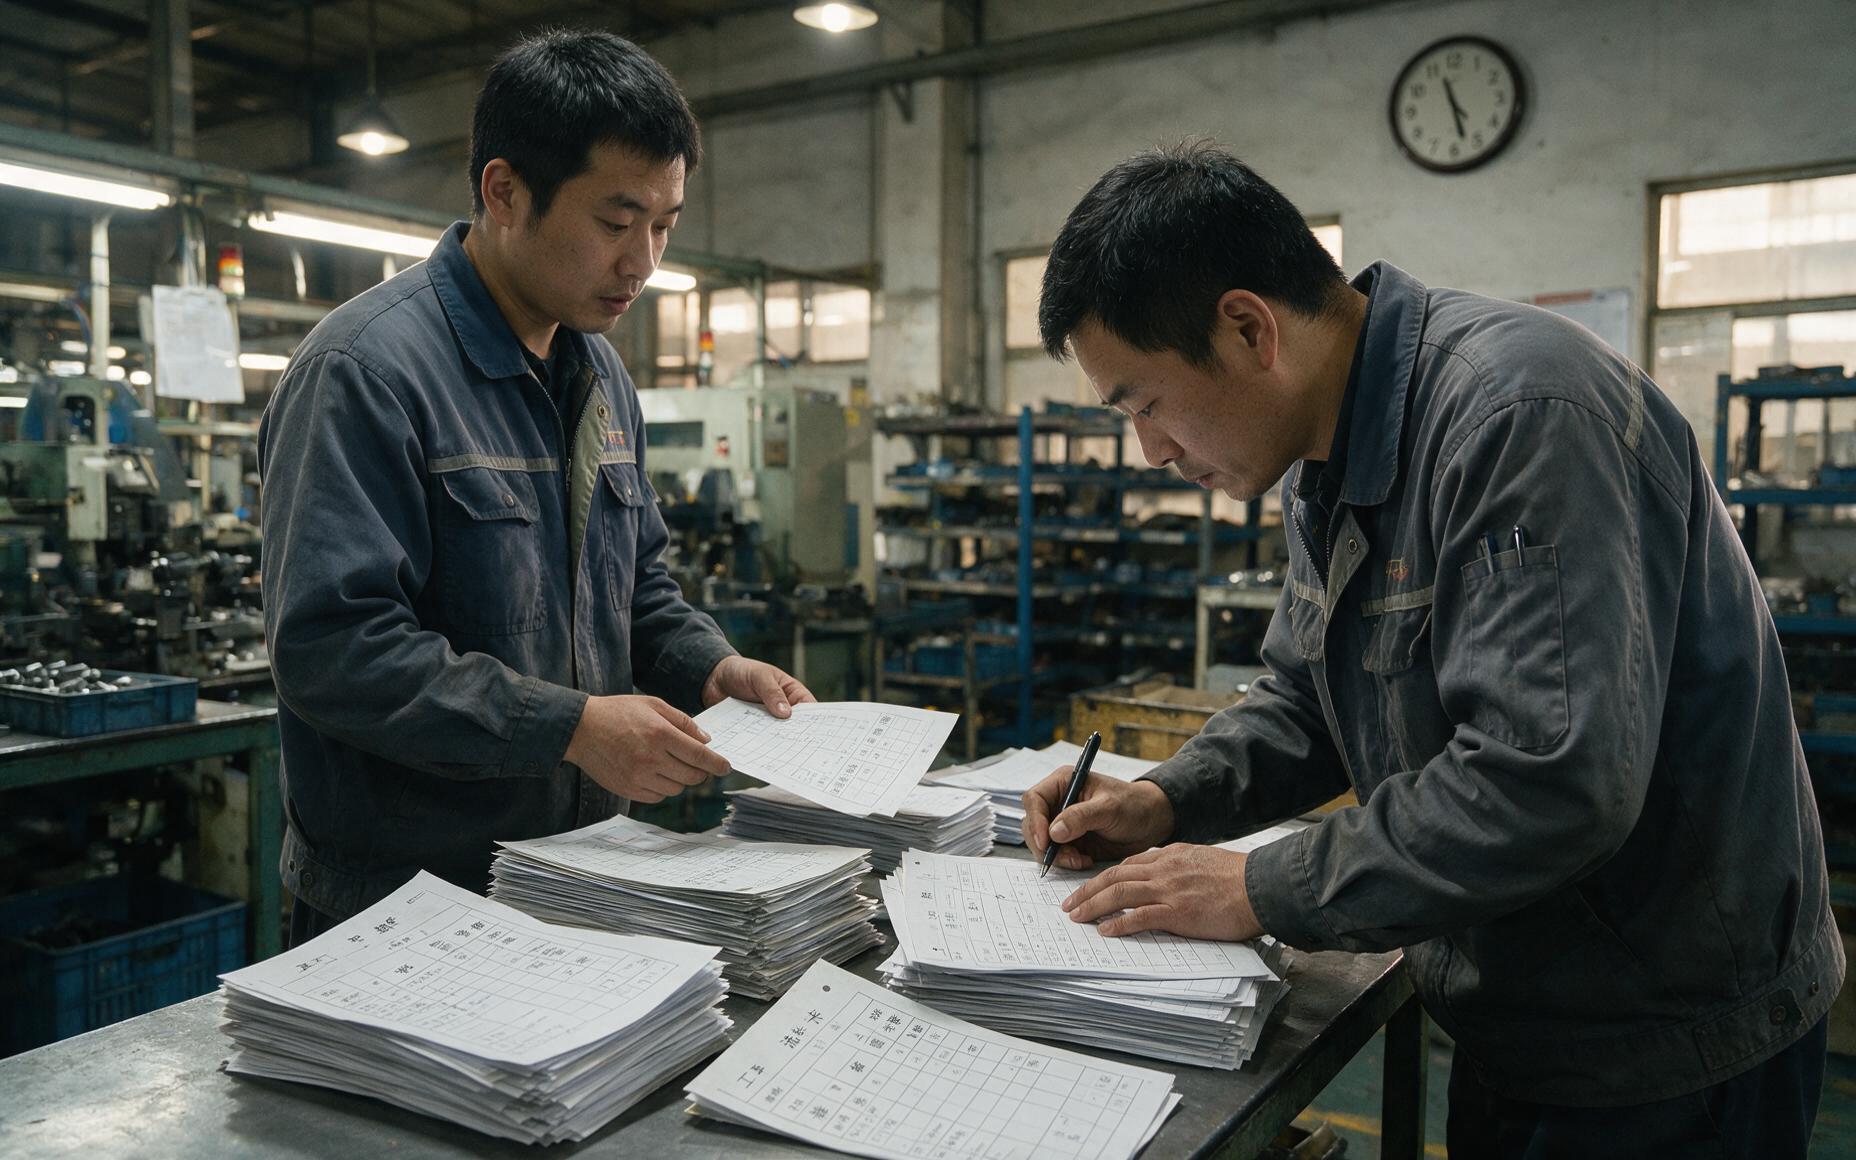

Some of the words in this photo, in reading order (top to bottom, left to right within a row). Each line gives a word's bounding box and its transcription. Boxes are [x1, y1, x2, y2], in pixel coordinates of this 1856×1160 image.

[1447, 52, 1463, 69] 12
[1426, 63, 1439, 79] 11
[1488, 68, 1499, 86] 2
[1410, 83, 1426, 99] 10
[1406, 103, 1417, 119] 9
[1429, 137, 1439, 153] 7
[1473, 132, 1483, 149] 5
[1449, 142, 1459, 156] 6
